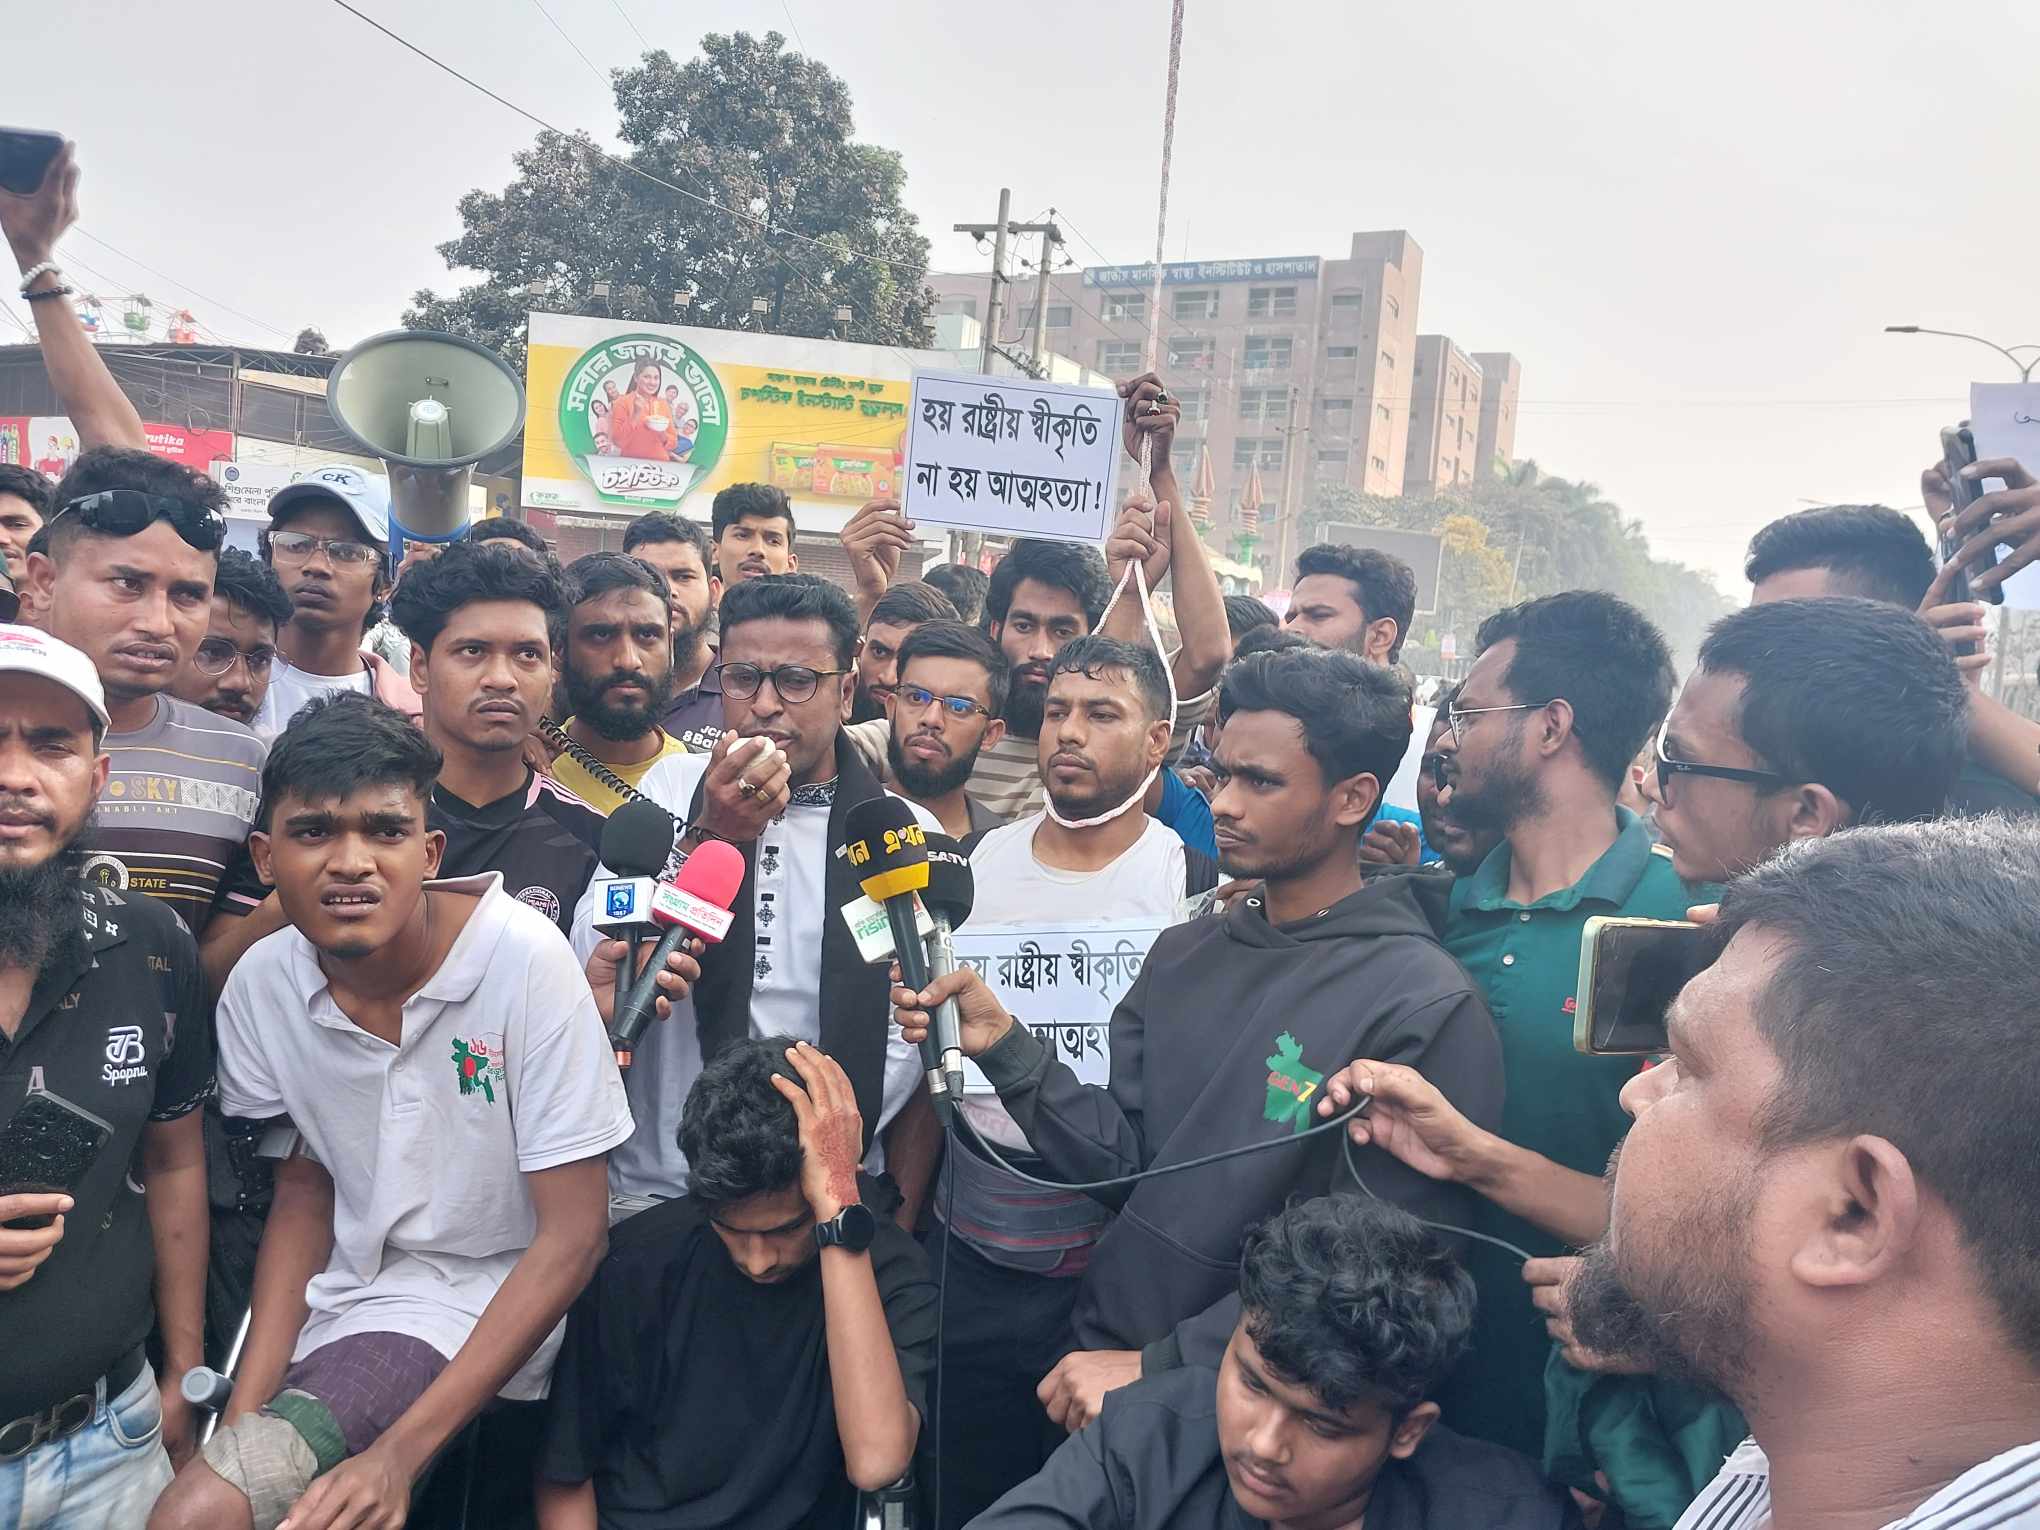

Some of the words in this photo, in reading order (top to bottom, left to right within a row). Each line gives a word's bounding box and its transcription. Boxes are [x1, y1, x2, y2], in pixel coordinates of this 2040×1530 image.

[567, 351, 613, 412] সবার
[610, 340, 687, 370] জন্যই
[684, 360, 721, 425] ভালো
[921, 398, 956, 435] হয়
[960, 392, 1025, 444] রাষ্ট্রীয়
[1028, 398, 1101, 464] স্বীকৃতি
[916, 461, 942, 497] না
[947, 466, 981, 503] হয়
[130, 776, 177, 801] SKY
[130, 877, 166, 889] STATE
[996, 940, 1062, 993] রাষ্ট্রীয়
